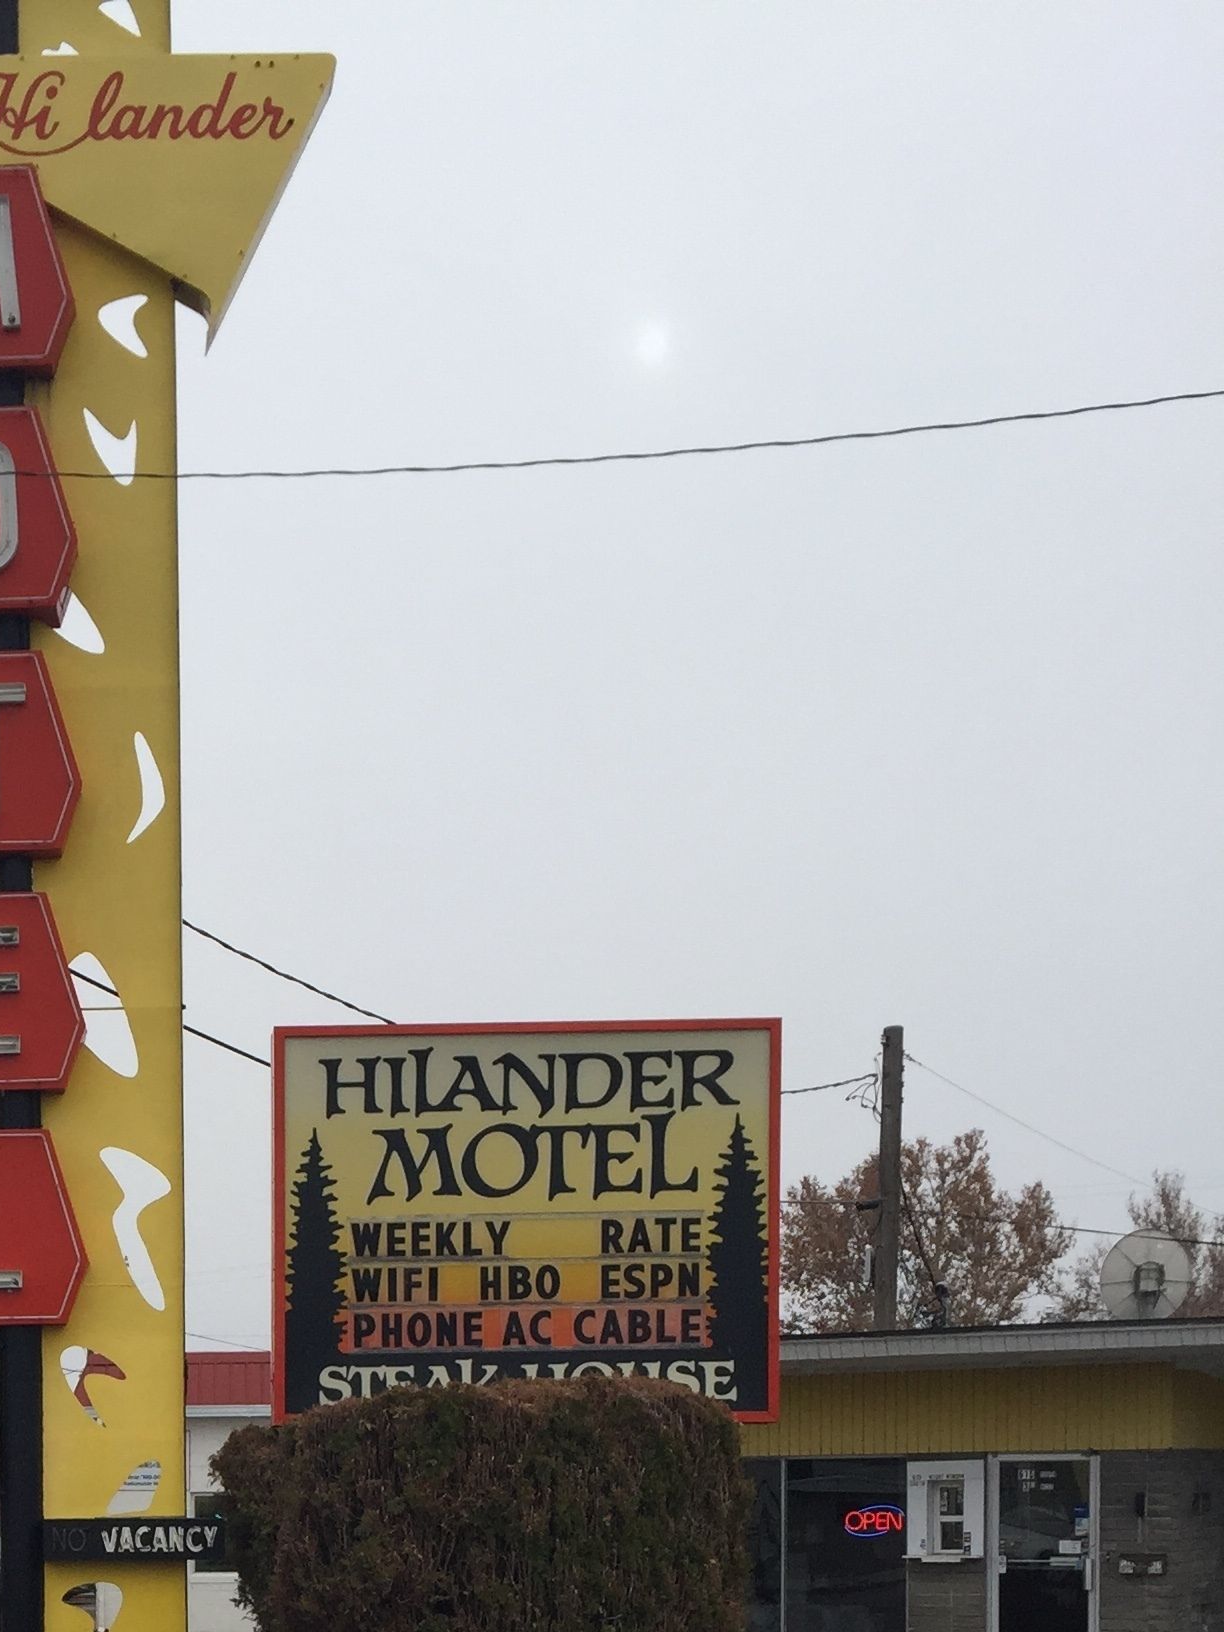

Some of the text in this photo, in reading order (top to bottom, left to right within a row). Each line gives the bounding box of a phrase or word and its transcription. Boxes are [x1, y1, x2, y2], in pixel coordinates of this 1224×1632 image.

[0, 70, 295, 156] lander
[318, 1047, 740, 1119] HILANDER
[366, 1111, 699, 1205] MOTEL
[351, 1218, 702, 1258] WEEKLY RATE
[352, 1262, 702, 1303] WIFI HBO ESPN
[353, 1307, 703, 1348] PHONE AC CABLE
[51, 1526, 219, 1553] NO VACANCY
[845, 1511, 903, 1530] OPEN
